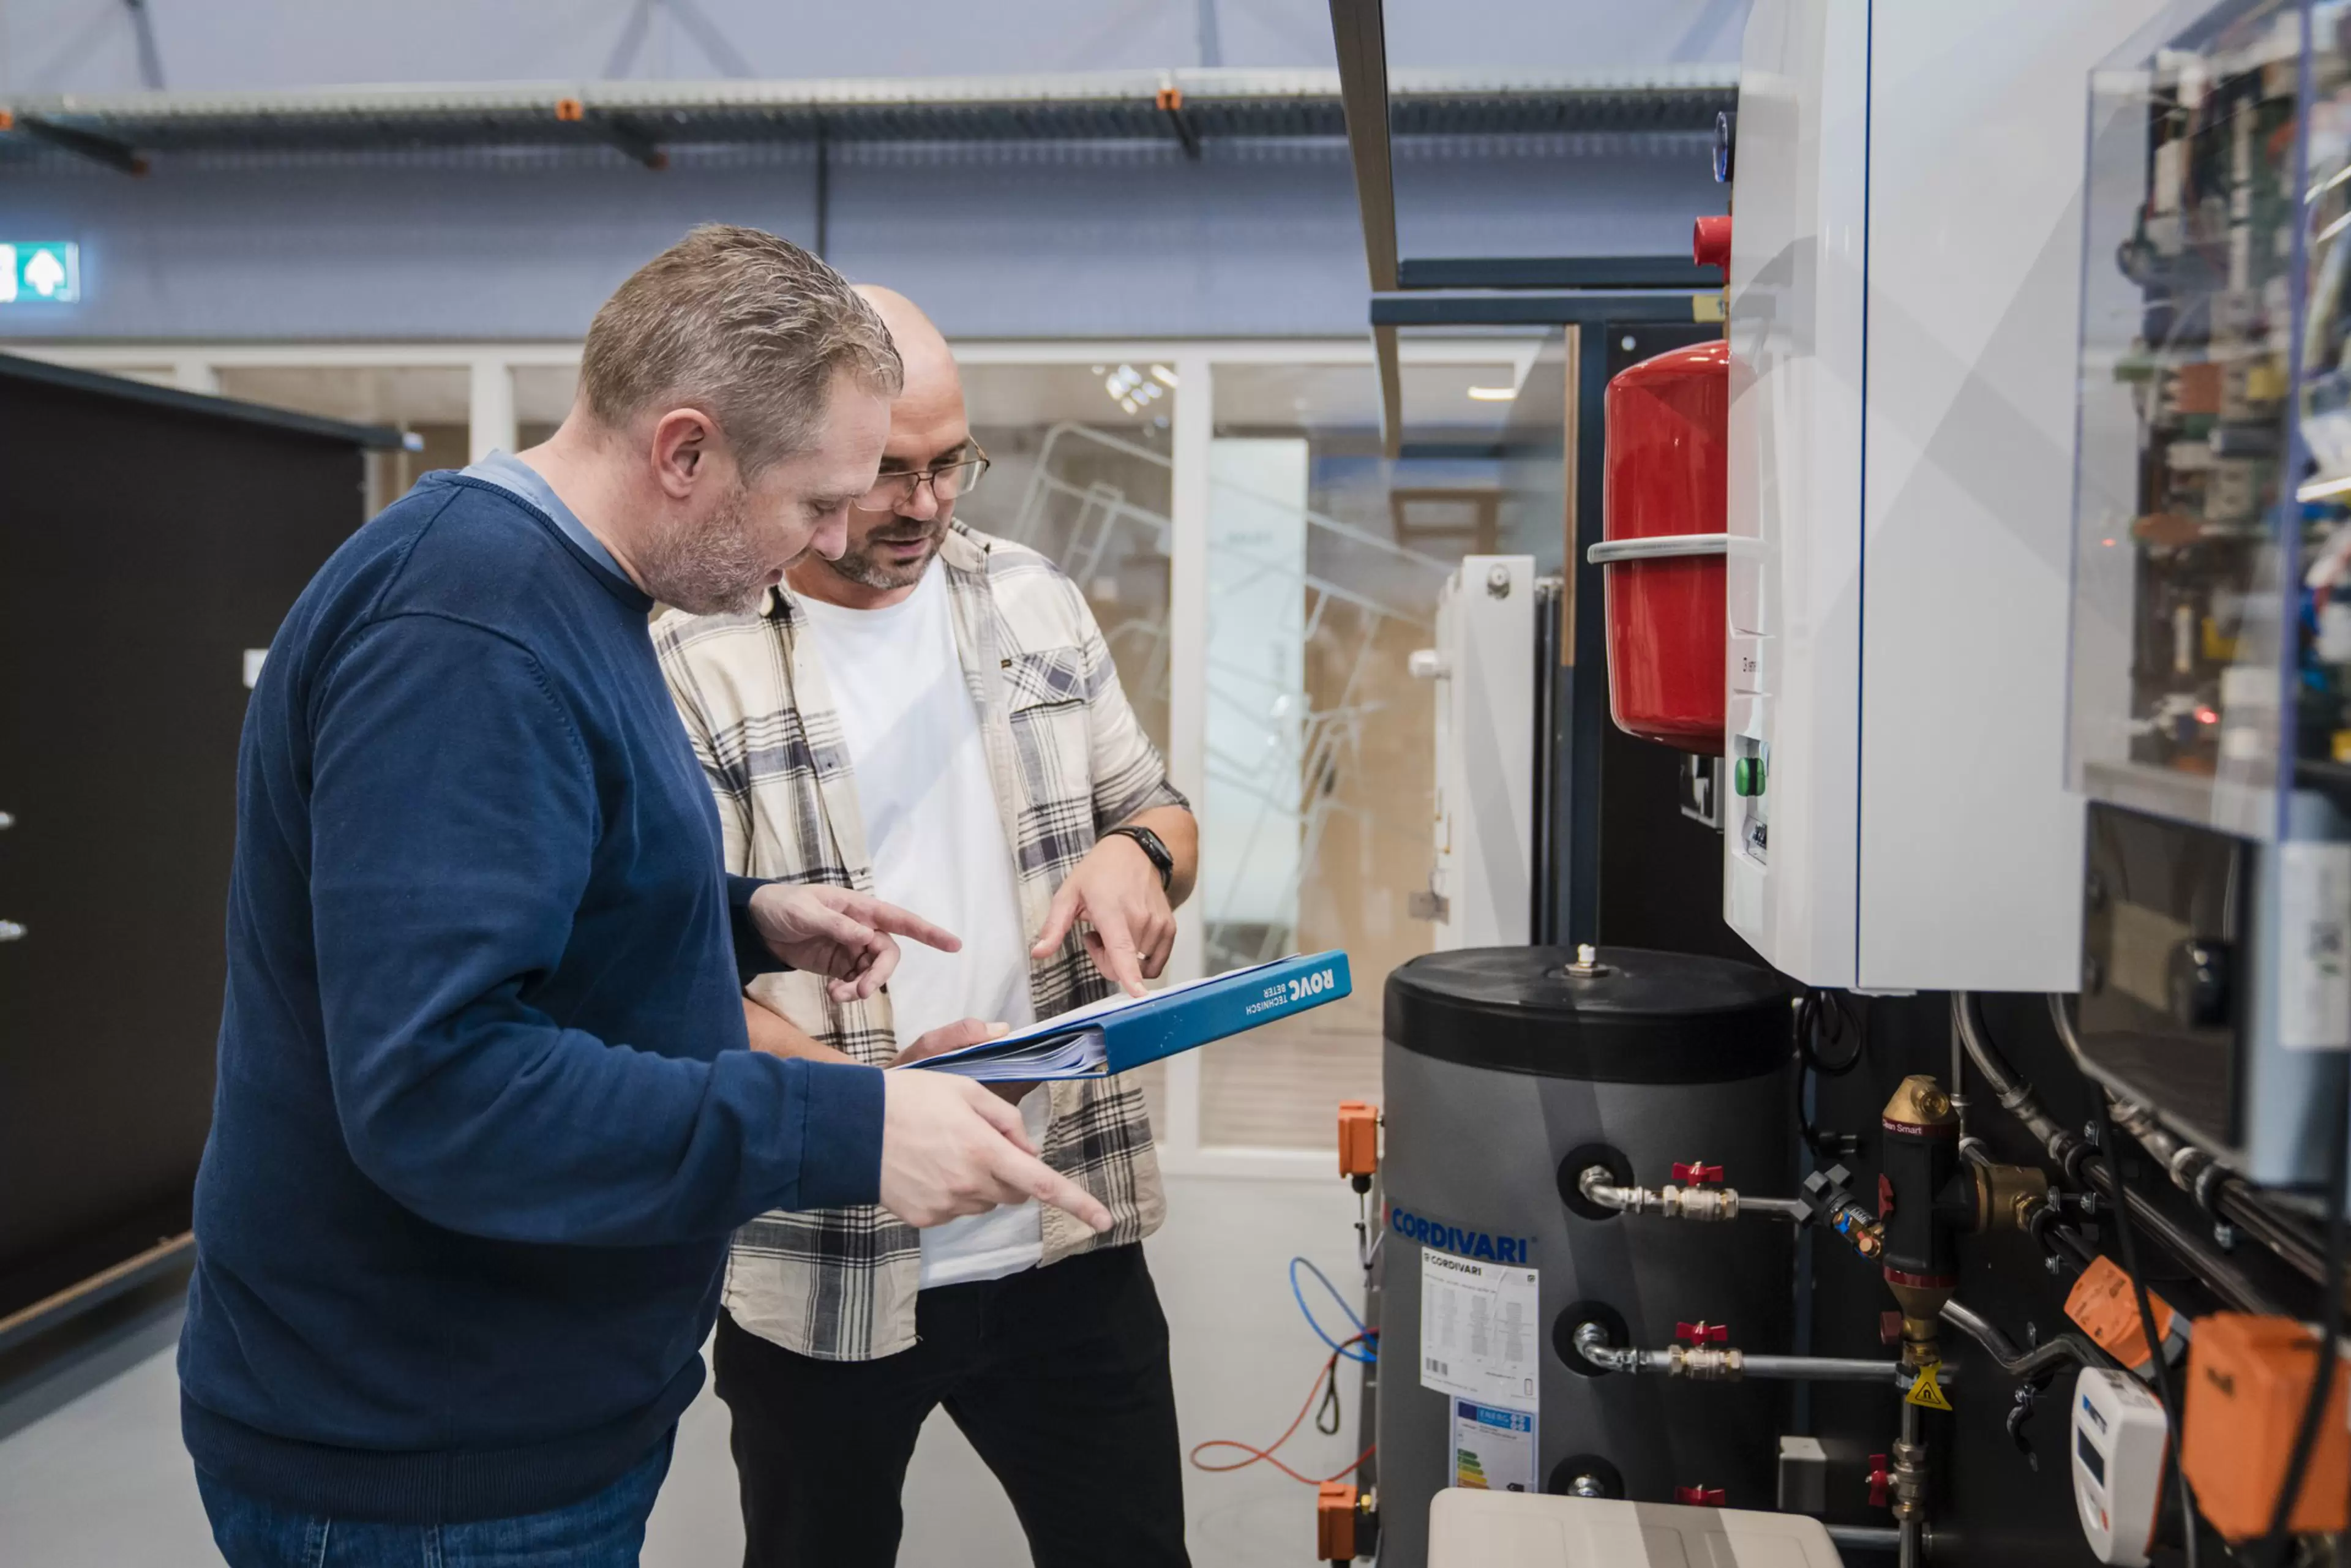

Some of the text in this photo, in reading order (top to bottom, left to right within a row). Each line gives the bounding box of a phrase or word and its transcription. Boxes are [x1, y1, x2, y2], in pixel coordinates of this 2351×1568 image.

[1264, 983, 1286, 998] BETER
[1288, 969, 1334, 1000] ROVC
[1246, 995, 1288, 1015] TECHNISCH
[1897, 1123, 1922, 1134] Smart
[1393, 1208, 1526, 1263] CORDIVARI
[1431, 1256, 1482, 1276] CORDIVARI
